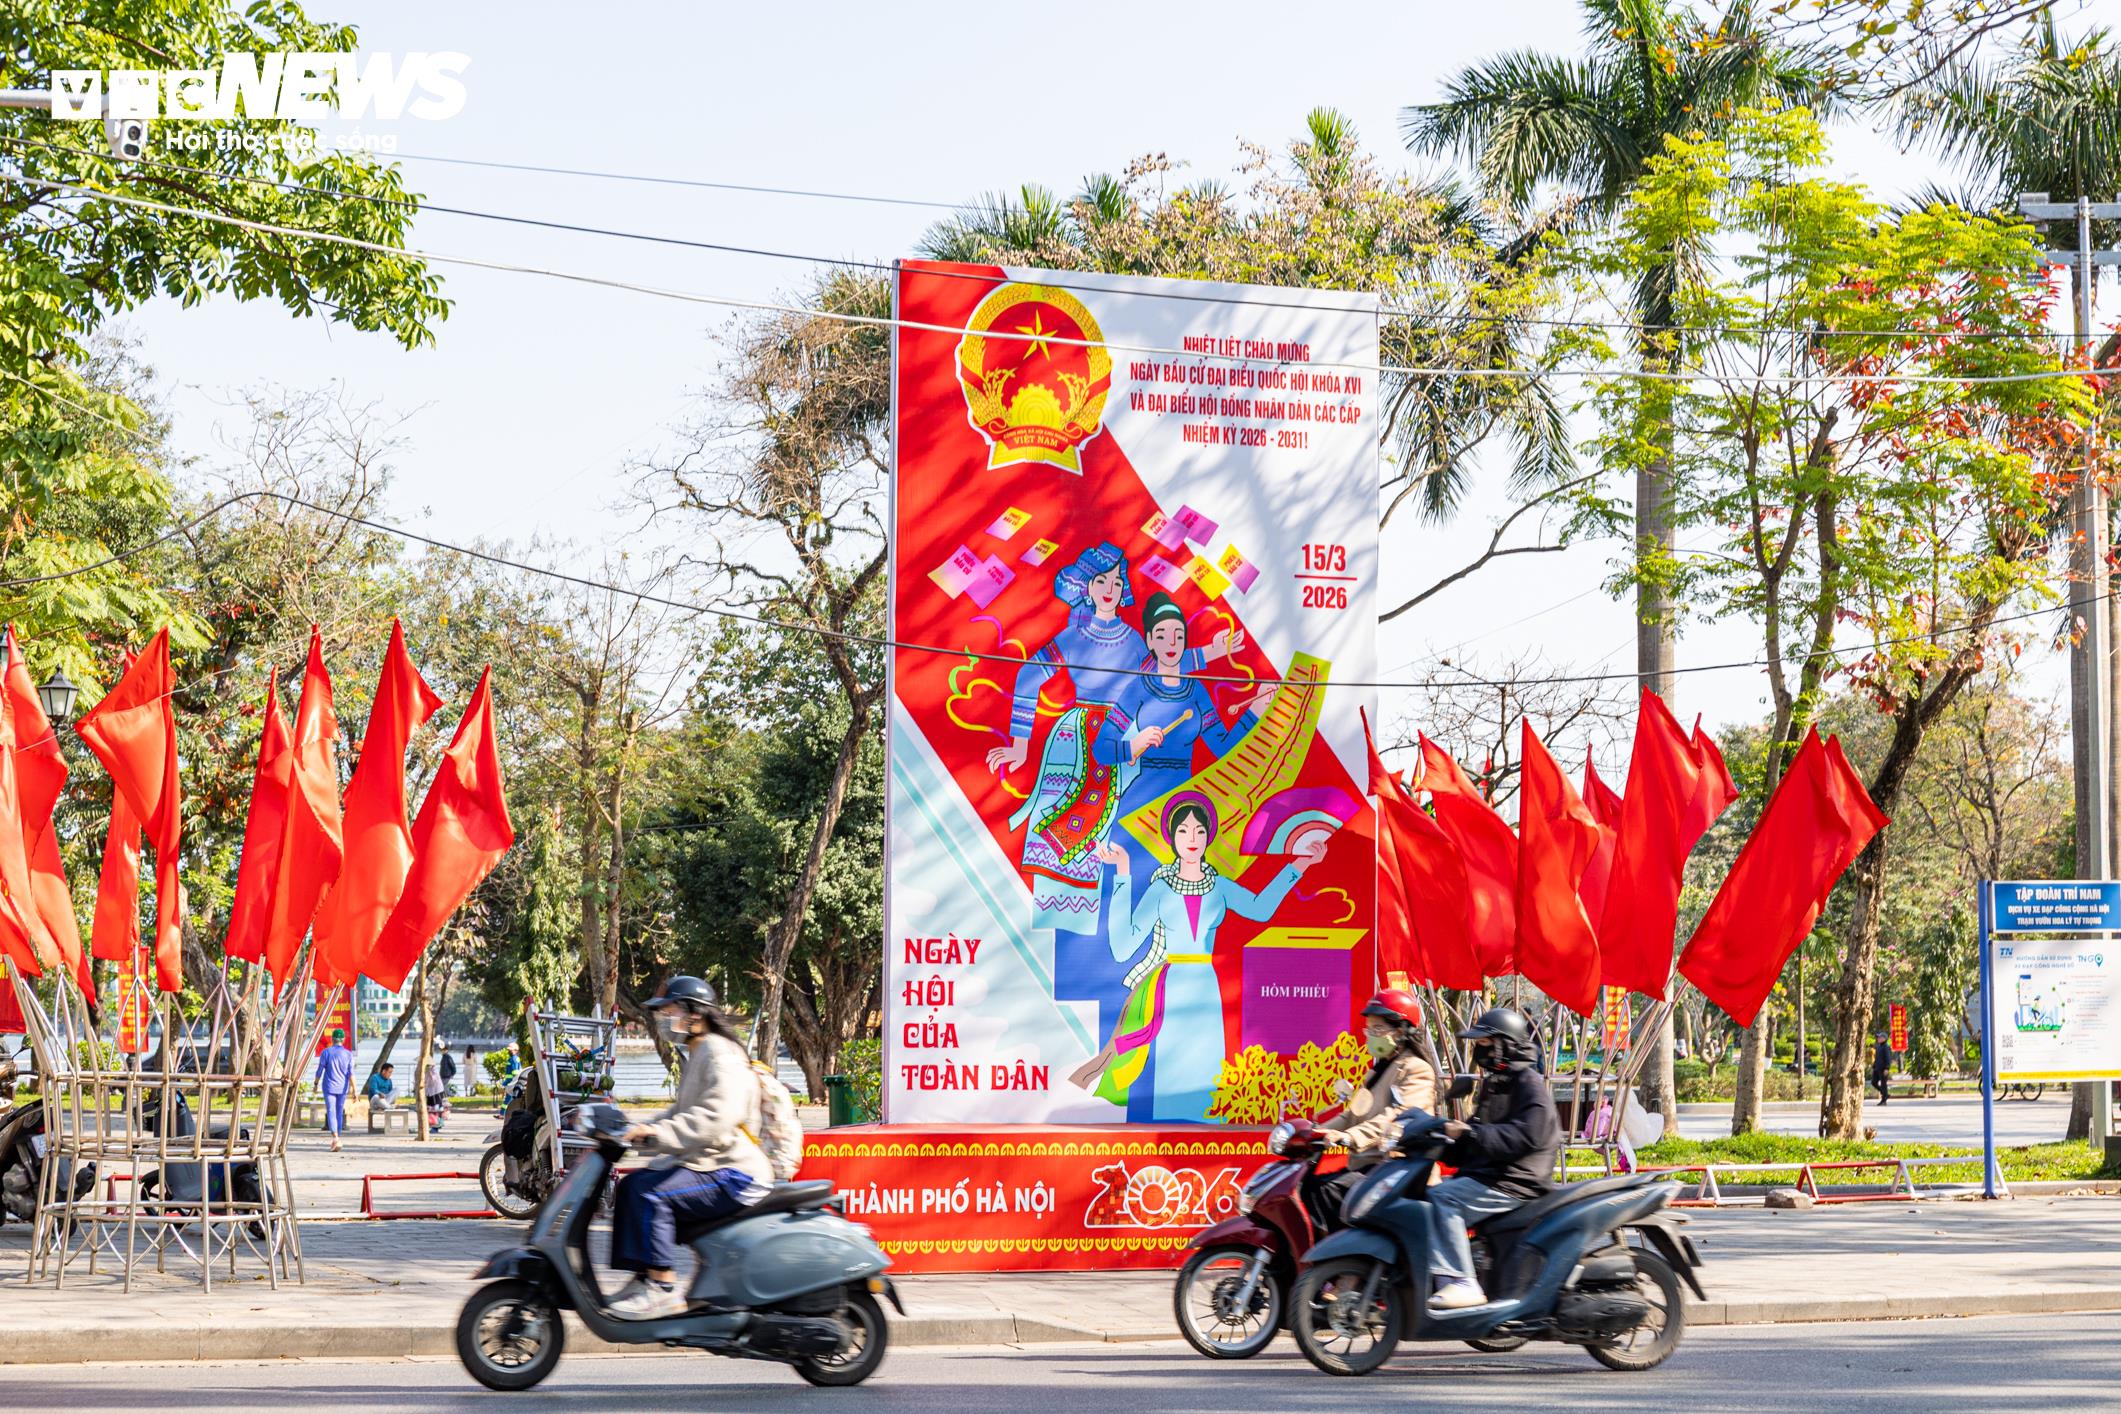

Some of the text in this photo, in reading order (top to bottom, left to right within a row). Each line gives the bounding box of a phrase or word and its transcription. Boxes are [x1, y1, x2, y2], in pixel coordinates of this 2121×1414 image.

[1183, 333, 1310, 362] NHIỆT LIỆT CHÀO MỪNG
[1130, 358, 1361, 395] NGÀY BẦU CỬ ĐẠI BIỂU QUỐC HỘI KHÓA XVI
[1130, 388, 1361, 424] VÀ ĐẠI BIỂU HỘI ĐỒNG NHÂN DÂN CÁC CẤP
[1013, 434, 1059, 447] VIỆT NAM
[1183, 421, 1219, 448] NHIỆM
[1223, 422, 1237, 446] KỲ
[1240, 428, 1267, 448] 2026
[1277, 430, 1308, 449] 2031!
[1301, 543, 1346, 571] 15/3
[1302, 585, 1347, 609] 2026
[2015, 886, 2102, 902] TẬP ĐOÀN TRÍ NAM
[2032, 905, 2041, 914] XE
[904, 932, 982, 964] NGÀY
[902, 974, 955, 1012] HỘI
[1261, 982, 1330, 998] HÒM PHIẾU
[903, 1015, 960, 1048] CỦA
[901, 1058, 1049, 1090] TOÀN DÂN
[838, 1177, 1055, 1219] THÀNH PHỐ HÀ NỘI
[1084, 1160, 1244, 1229] 2026
